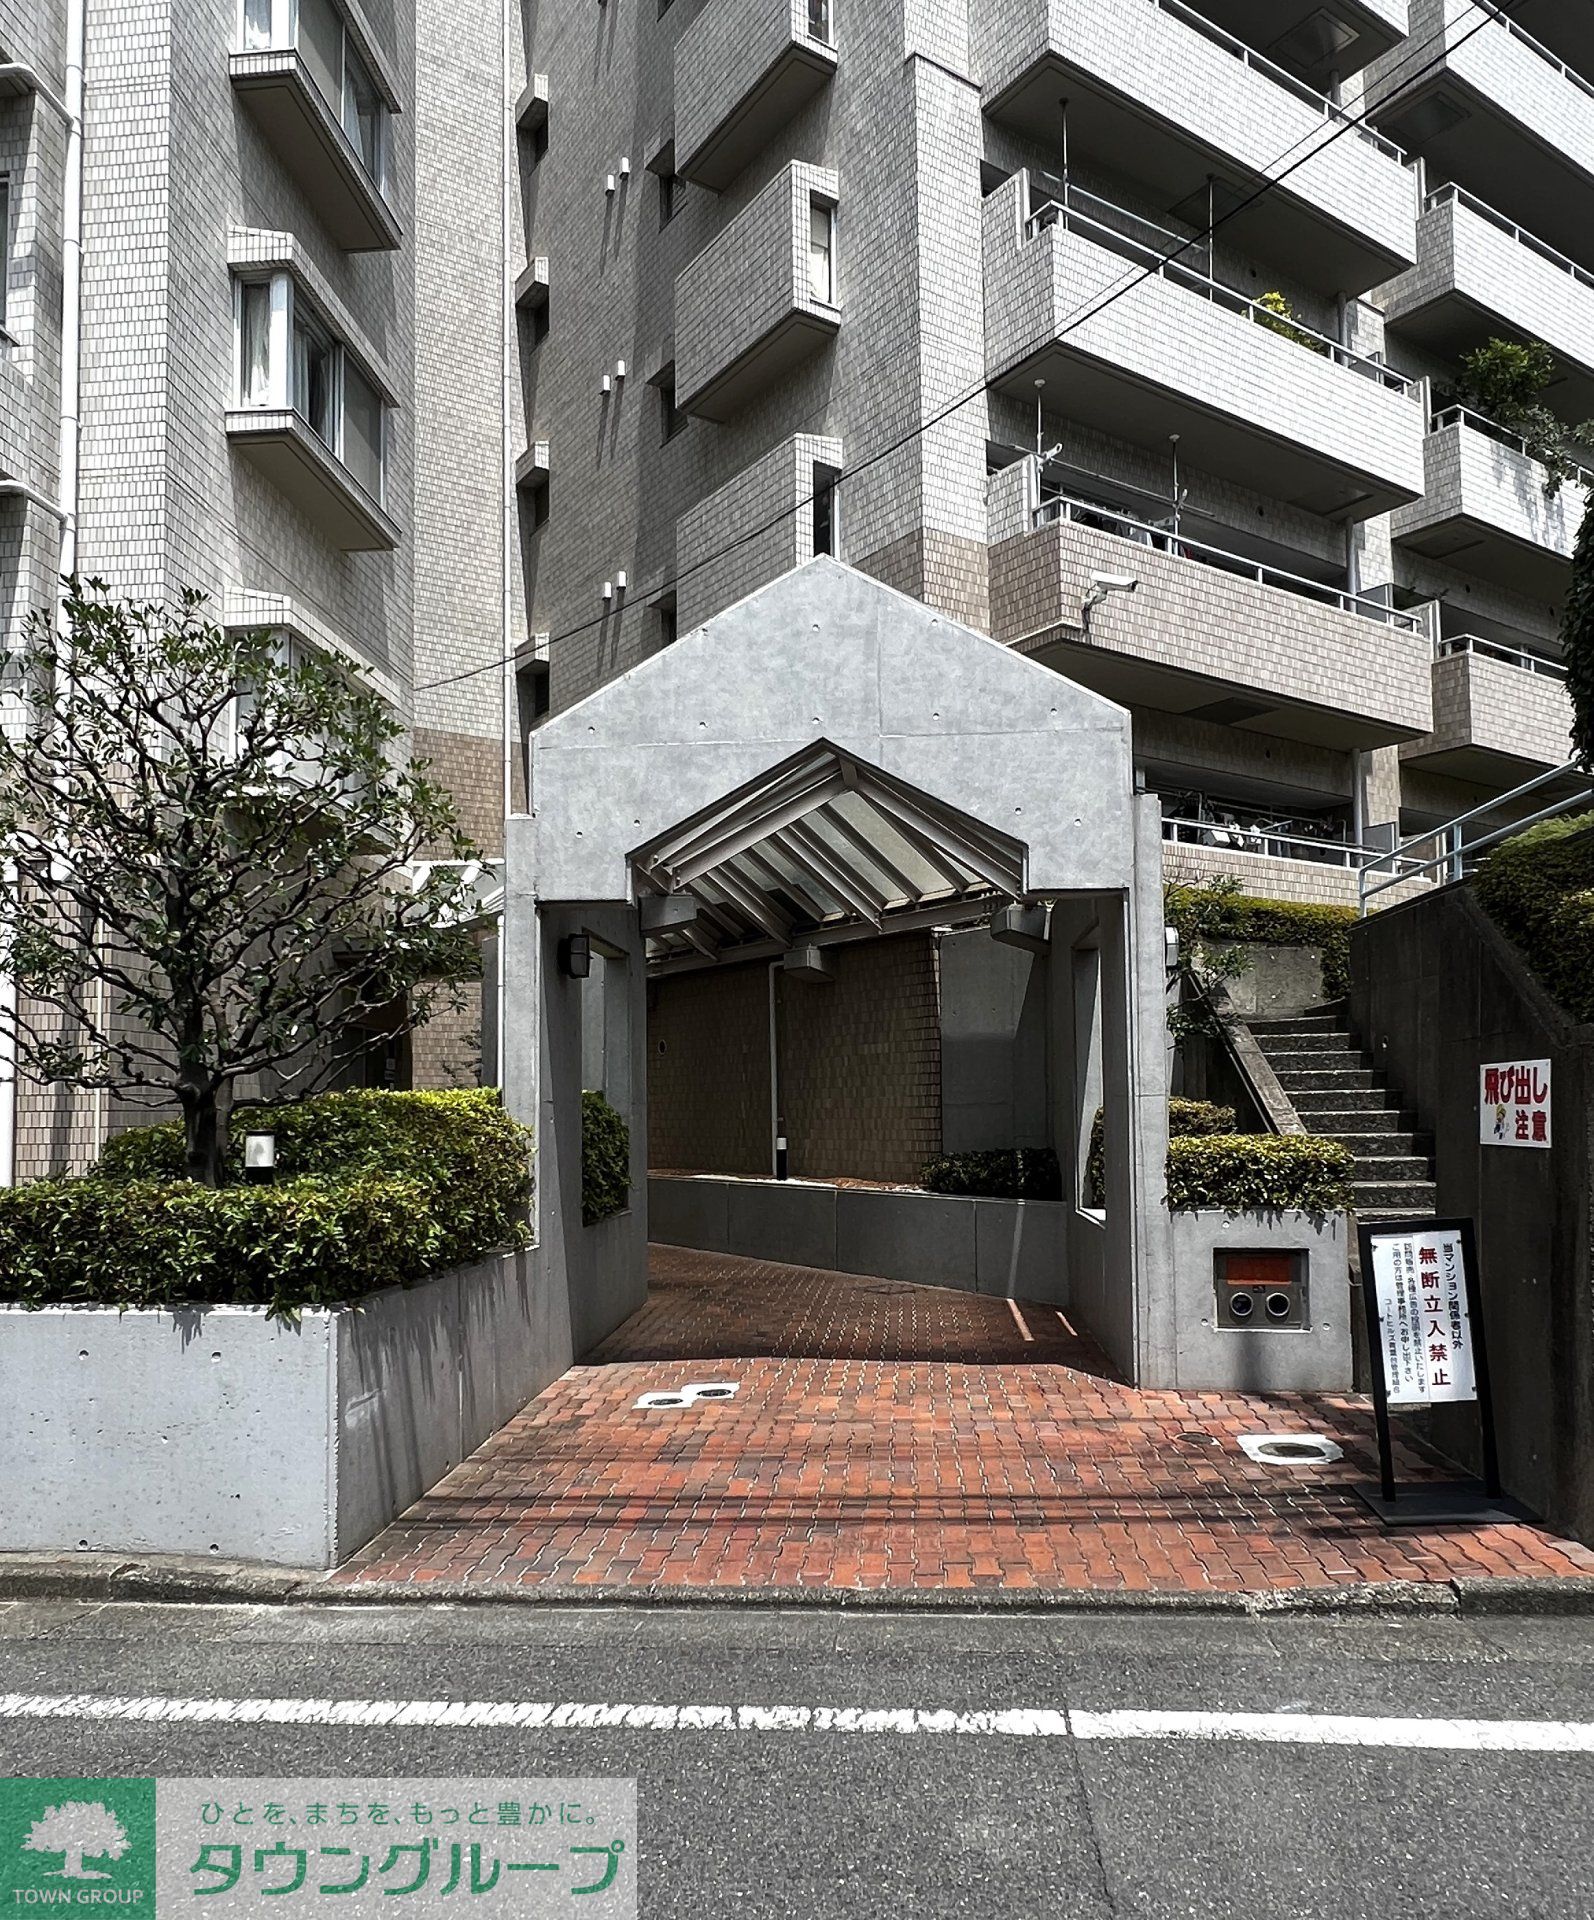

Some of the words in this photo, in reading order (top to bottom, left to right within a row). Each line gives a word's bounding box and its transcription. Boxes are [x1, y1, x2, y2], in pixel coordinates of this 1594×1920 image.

[1484, 1065, 1548, 1105] 飛び出し
[1515, 1109, 1547, 1142] 注意
[1418, 1246, 1451, 1386] 無断立入禁止
[1443, 1243, 1463, 1350] 当マンション関係者以外
